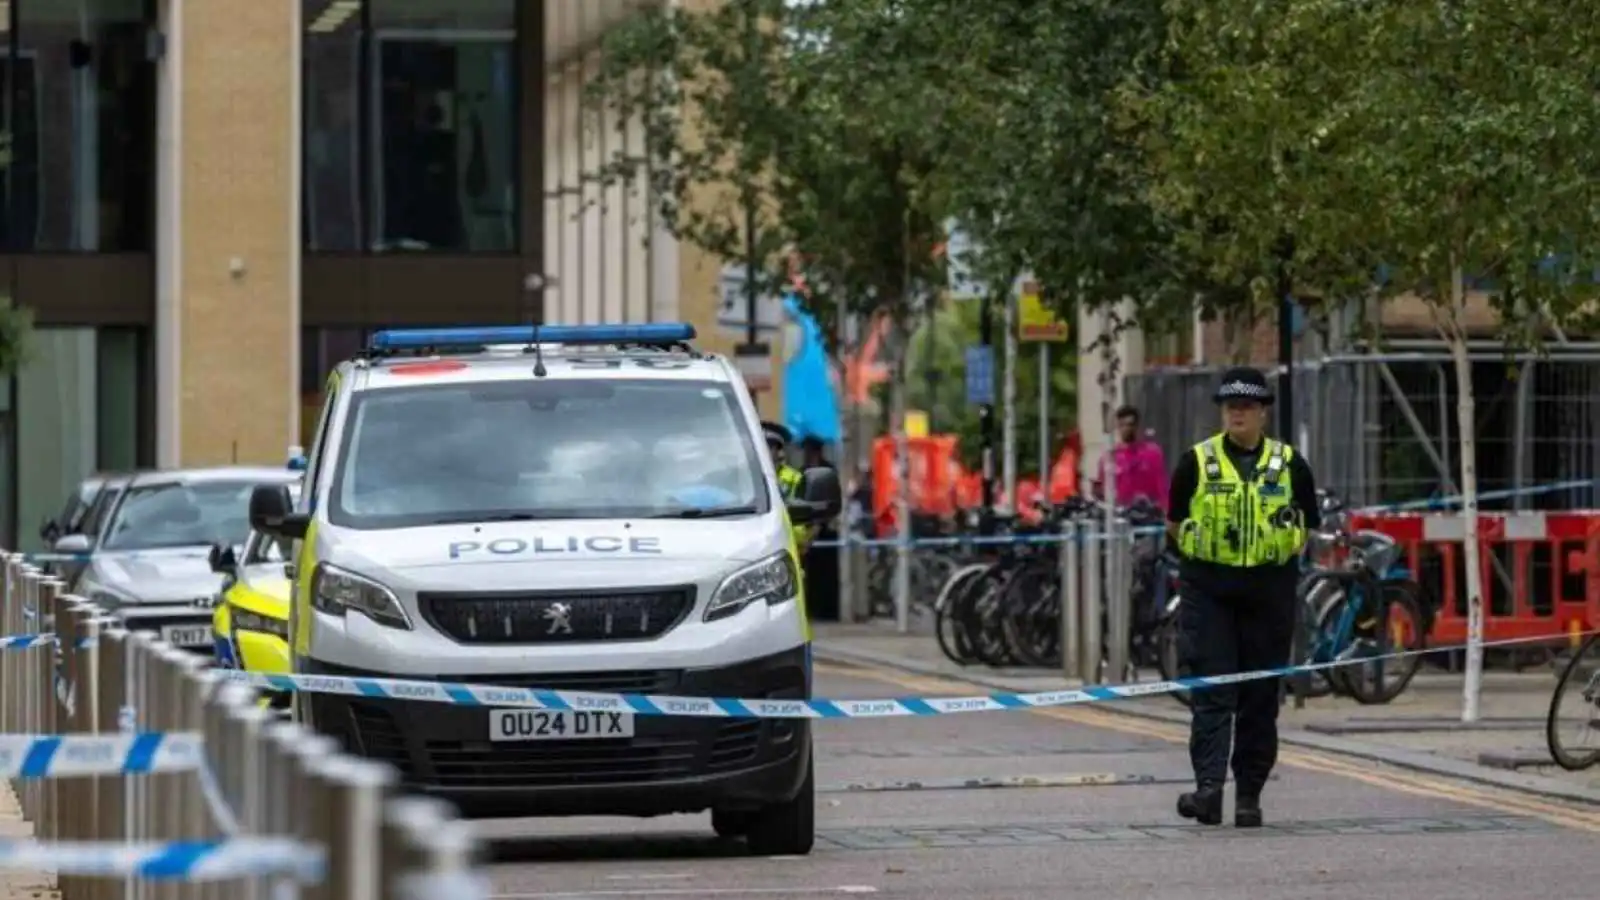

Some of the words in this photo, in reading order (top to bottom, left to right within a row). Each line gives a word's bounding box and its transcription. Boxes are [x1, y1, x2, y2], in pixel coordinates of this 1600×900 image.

[449, 536, 662, 559] POLICE
[501, 713, 566, 736] OU24
[574, 711, 622, 734] DTX
